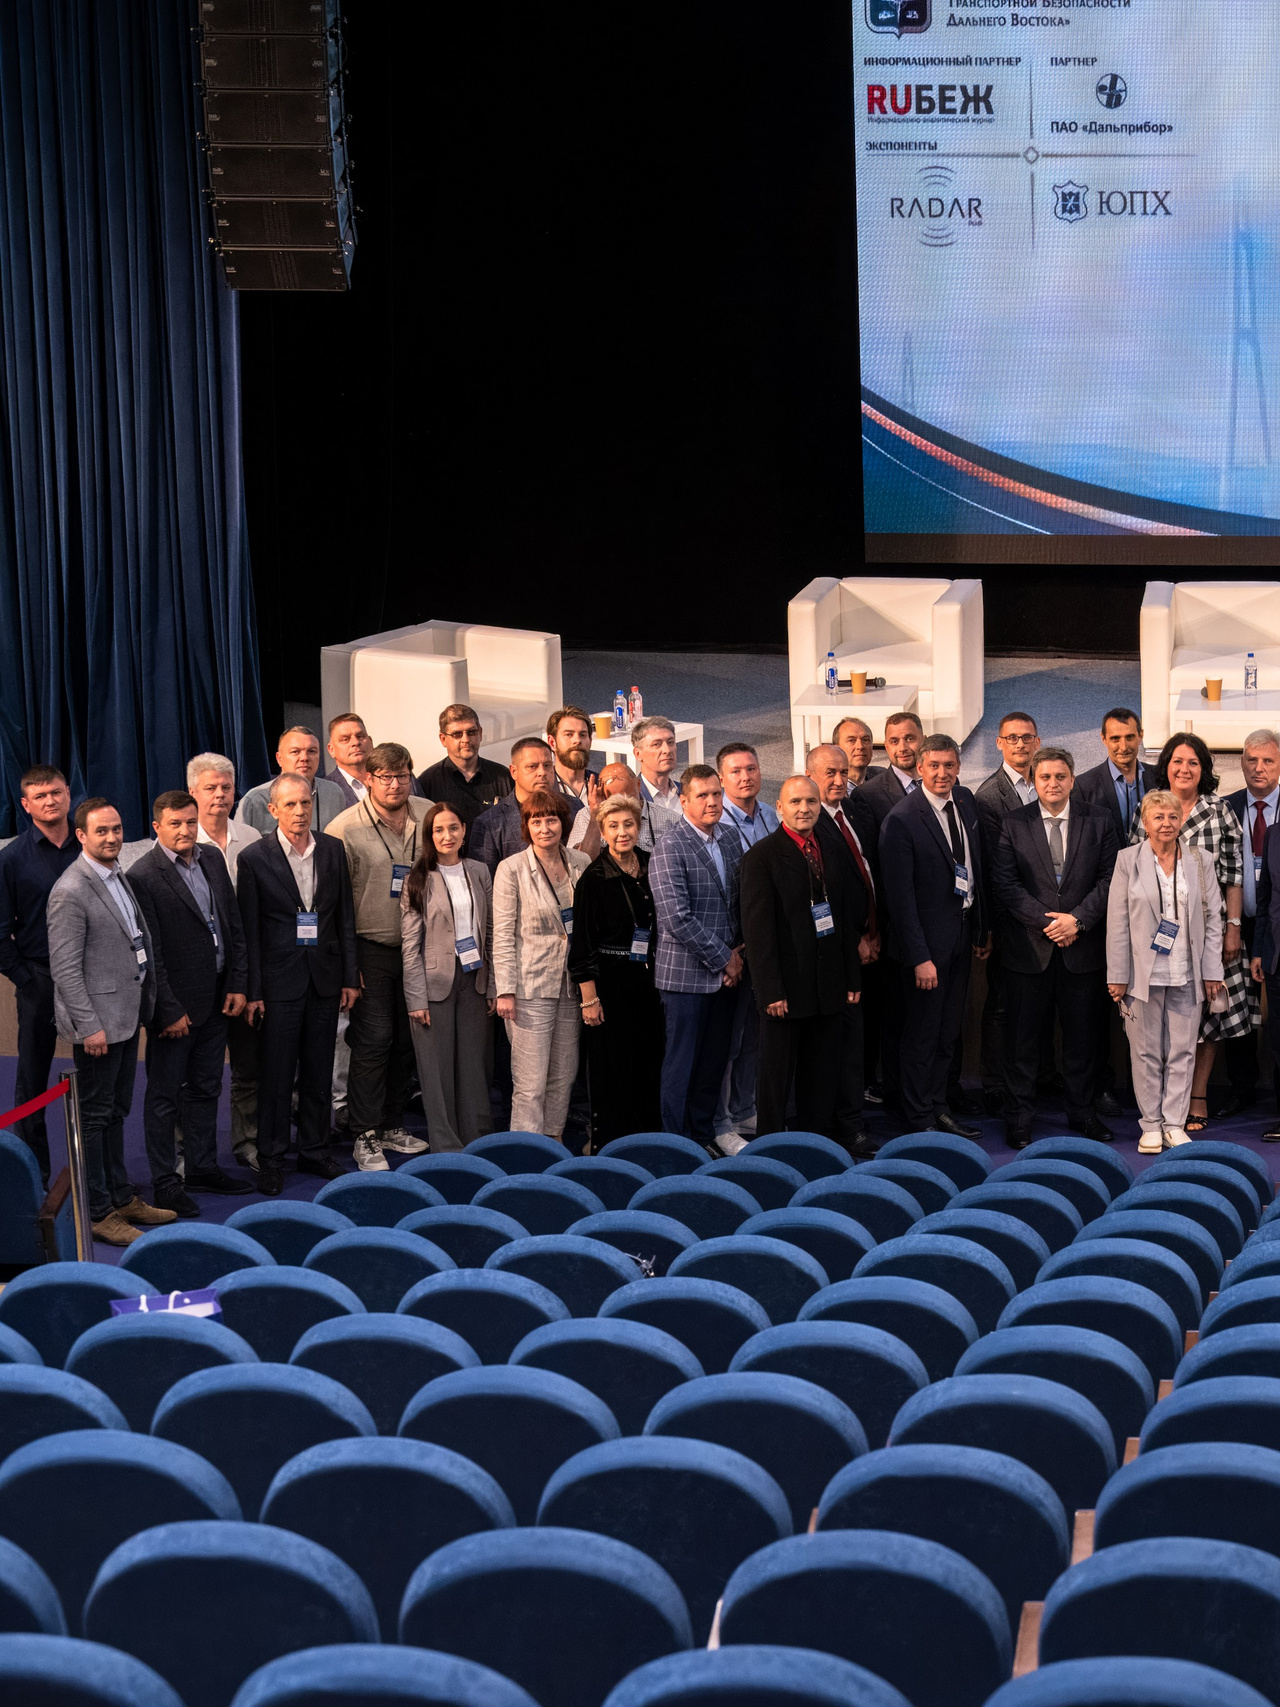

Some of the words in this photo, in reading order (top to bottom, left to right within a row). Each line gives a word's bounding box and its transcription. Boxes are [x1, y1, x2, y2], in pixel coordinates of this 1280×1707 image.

[864, 55, 972, 67] ИНФОРМАЦИОННЫЙ
[974, 56, 1021, 67] ПАРТНЕР
[1050, 56, 1098, 67] ПАРТНЕР
[1050, 121, 1079, 133] ПАО
[1082, 121, 1174, 135] «Дальприбор»
[865, 141, 938, 151] ЭКСПОНЕНТЫ
[890, 197, 983, 219] RADAR
[1098, 190, 1173, 216] ЮПХ
